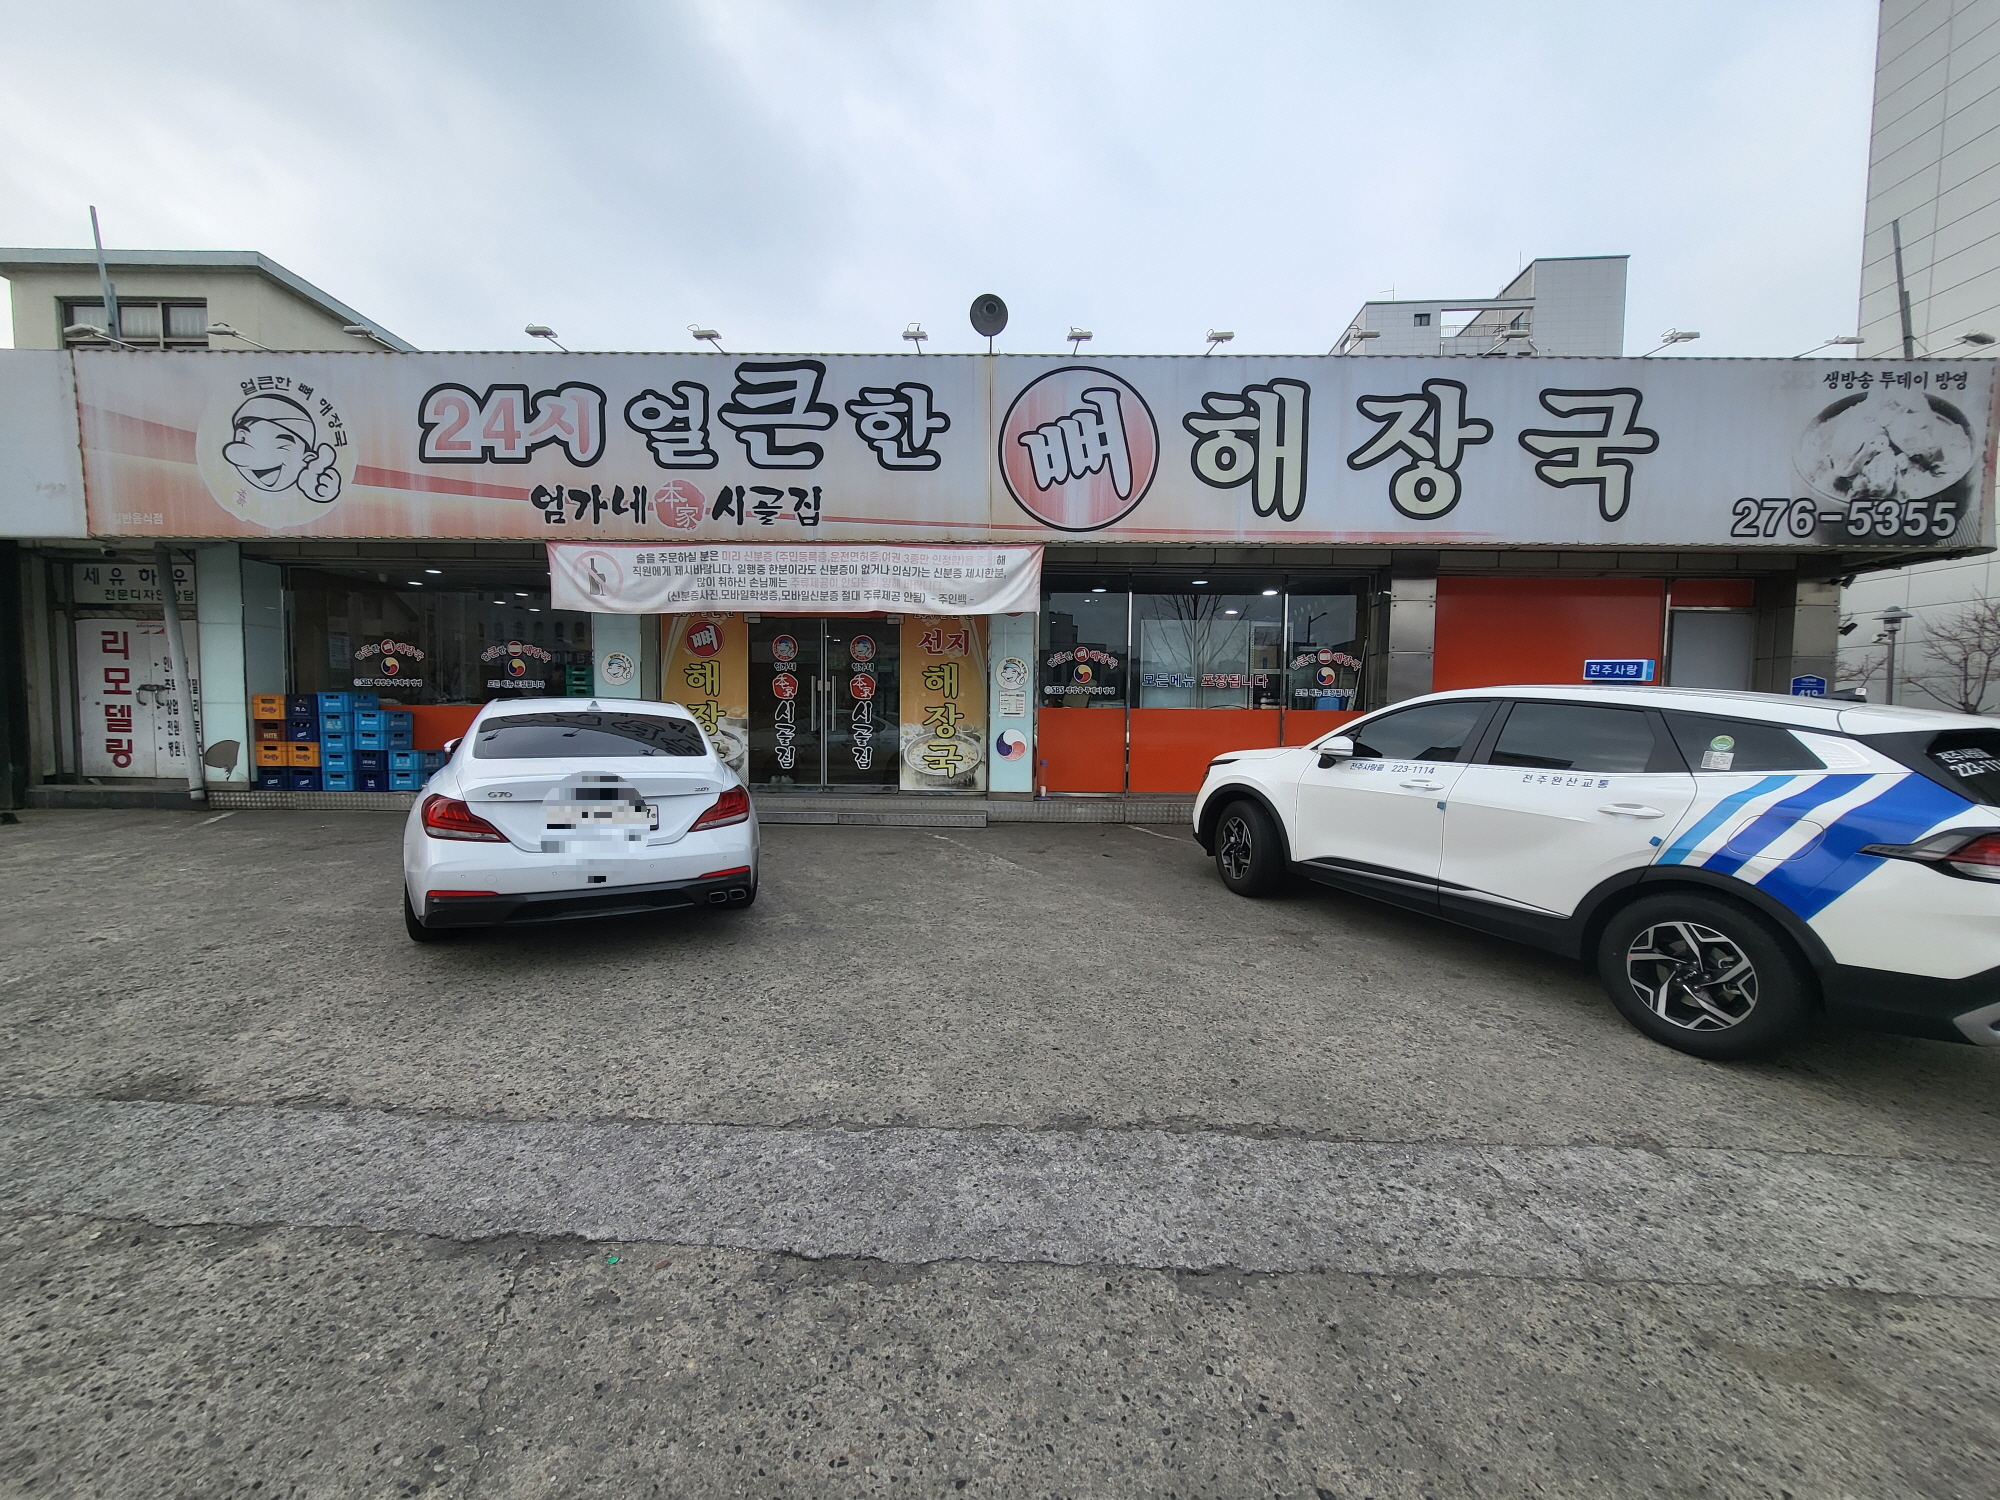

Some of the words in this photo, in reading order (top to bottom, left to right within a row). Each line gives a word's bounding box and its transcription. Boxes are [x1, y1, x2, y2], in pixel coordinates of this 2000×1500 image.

[1823, 371, 1875, 390] 생방송
[1879, 371, 1929, 390] 투데이
[1935, 371, 1968, 391] 방영
[240, 375, 292, 396] 얼큰한
[298, 382, 315, 401] 뼈
[319, 397, 348, 448] 해장국
[418, 381, 606, 468] 24시
[623, 359, 952, 471] 얼큰한
[1018, 386, 1134, 500] 뼈
[1182, 377, 1660, 522] 해장국
[530, 484, 648, 525] 엄가네
[711, 485, 823, 527] 시골집
[1730, 497, 1958, 539] 276-5355
[636, 553, 656, 564] 술을
[658, 551, 697, 564] 주문하실
[700, 550, 719, 562] 분은
[722, 550, 741, 561] 미리
[743, 550, 773, 562] 신분증
[904, 553, 930, 565] 3종만
[632, 565, 672, 577] 직원에게
[737, 563, 766, 575] 일행중
[768, 563, 817, 576] 한분이라도
[820, 564, 858, 576] 신분증이
[861, 563, 891, 576] 없거나
[892, 565, 931, 578] 의심가는
[933, 567, 963, 579] 신분증
[965, 567, 1007, 579] 제시한분,
[697, 576, 716, 588] 많이
[718, 576, 747, 588] 취하신
[749, 576, 788, 588] 손님께는
[790, 577, 838, 589] 주류제공이
[841, 590, 861, 602] 절대
[863, 589, 901, 602] 주류제공
[903, 591, 926, 604] 안됨)
[938, 593, 967, 605] 주인백
[689, 625, 719, 651] 뼈
[917, 628, 971, 656] 선지
[1200, 673, 1269, 689] 포장됩니다
[1589, 664, 1639, 677] 전주사랑
[101, 630, 133, 768] 리모델링
[922, 662, 965, 778] 해장국
[774, 700, 797, 769] 시골집
[851, 701, 874, 770] 시골집
[1391, 764, 1435, 775] 223-1114
[487, 791, 513, 799] G70
